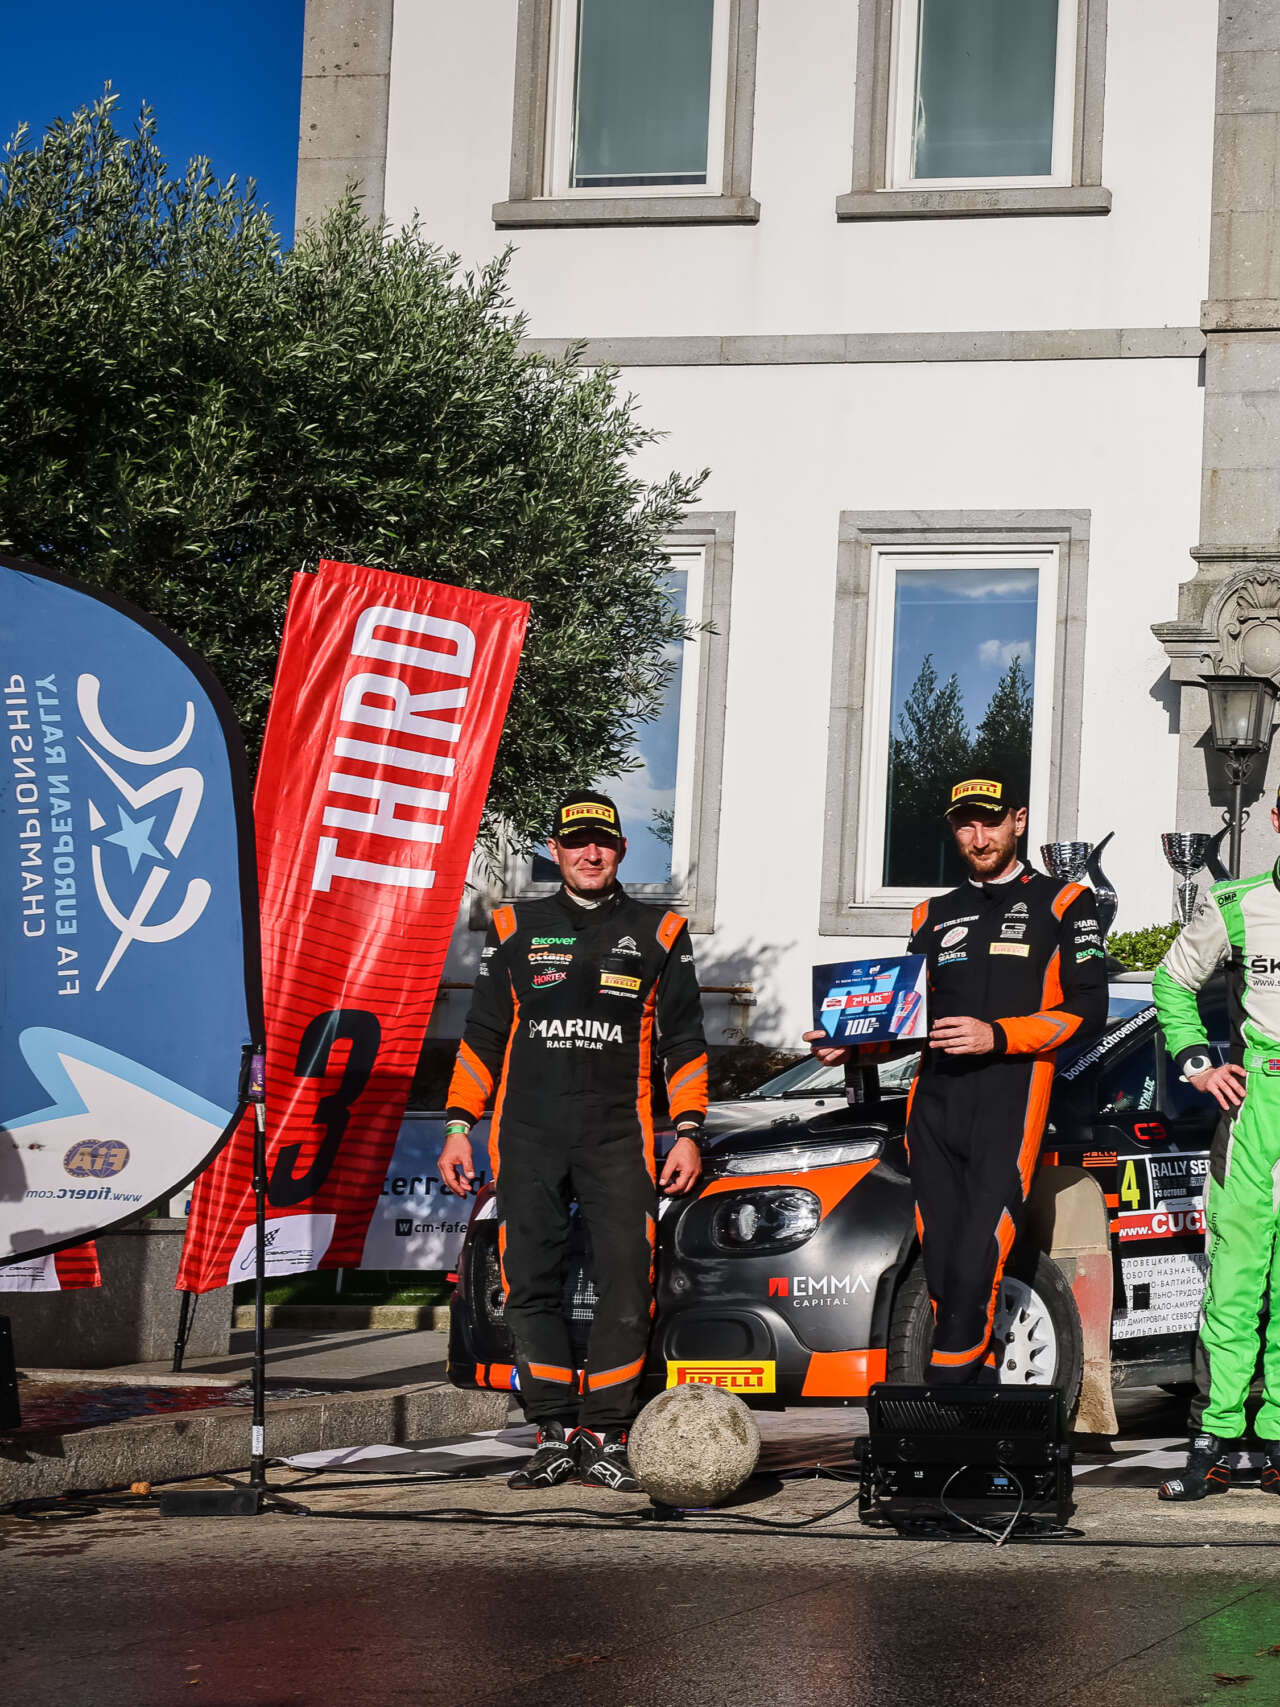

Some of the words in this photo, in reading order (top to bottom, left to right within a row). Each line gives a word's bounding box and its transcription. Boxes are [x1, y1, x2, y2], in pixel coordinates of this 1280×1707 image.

[311, 604, 478, 893] THIRD
[953, 780, 998, 797] PIRELLI
[565, 806, 612, 819] PIRELLI
[1217, 892, 1238, 906] OMP
[531, 937, 577, 946] ekover
[527, 952, 573, 964] octane
[533, 971, 567, 985] HORTEX
[863, 993, 883, 1004] PLACE
[529, 1019, 623, 1044] MARINA
[546, 1040, 572, 1049] RACE
[575, 1039, 603, 1050] WEAR
[268, 1008, 382, 1208] 3
[1151, 1161, 1187, 1178] RALLY
[1121, 1160, 1140, 1209] 4
[1119, 1212, 1206, 1238] www.CUC
[793, 1275, 870, 1296] EMMA
[793, 1297, 848, 1307] CAPITAL
[677, 1366, 765, 1388] PIRELLI
